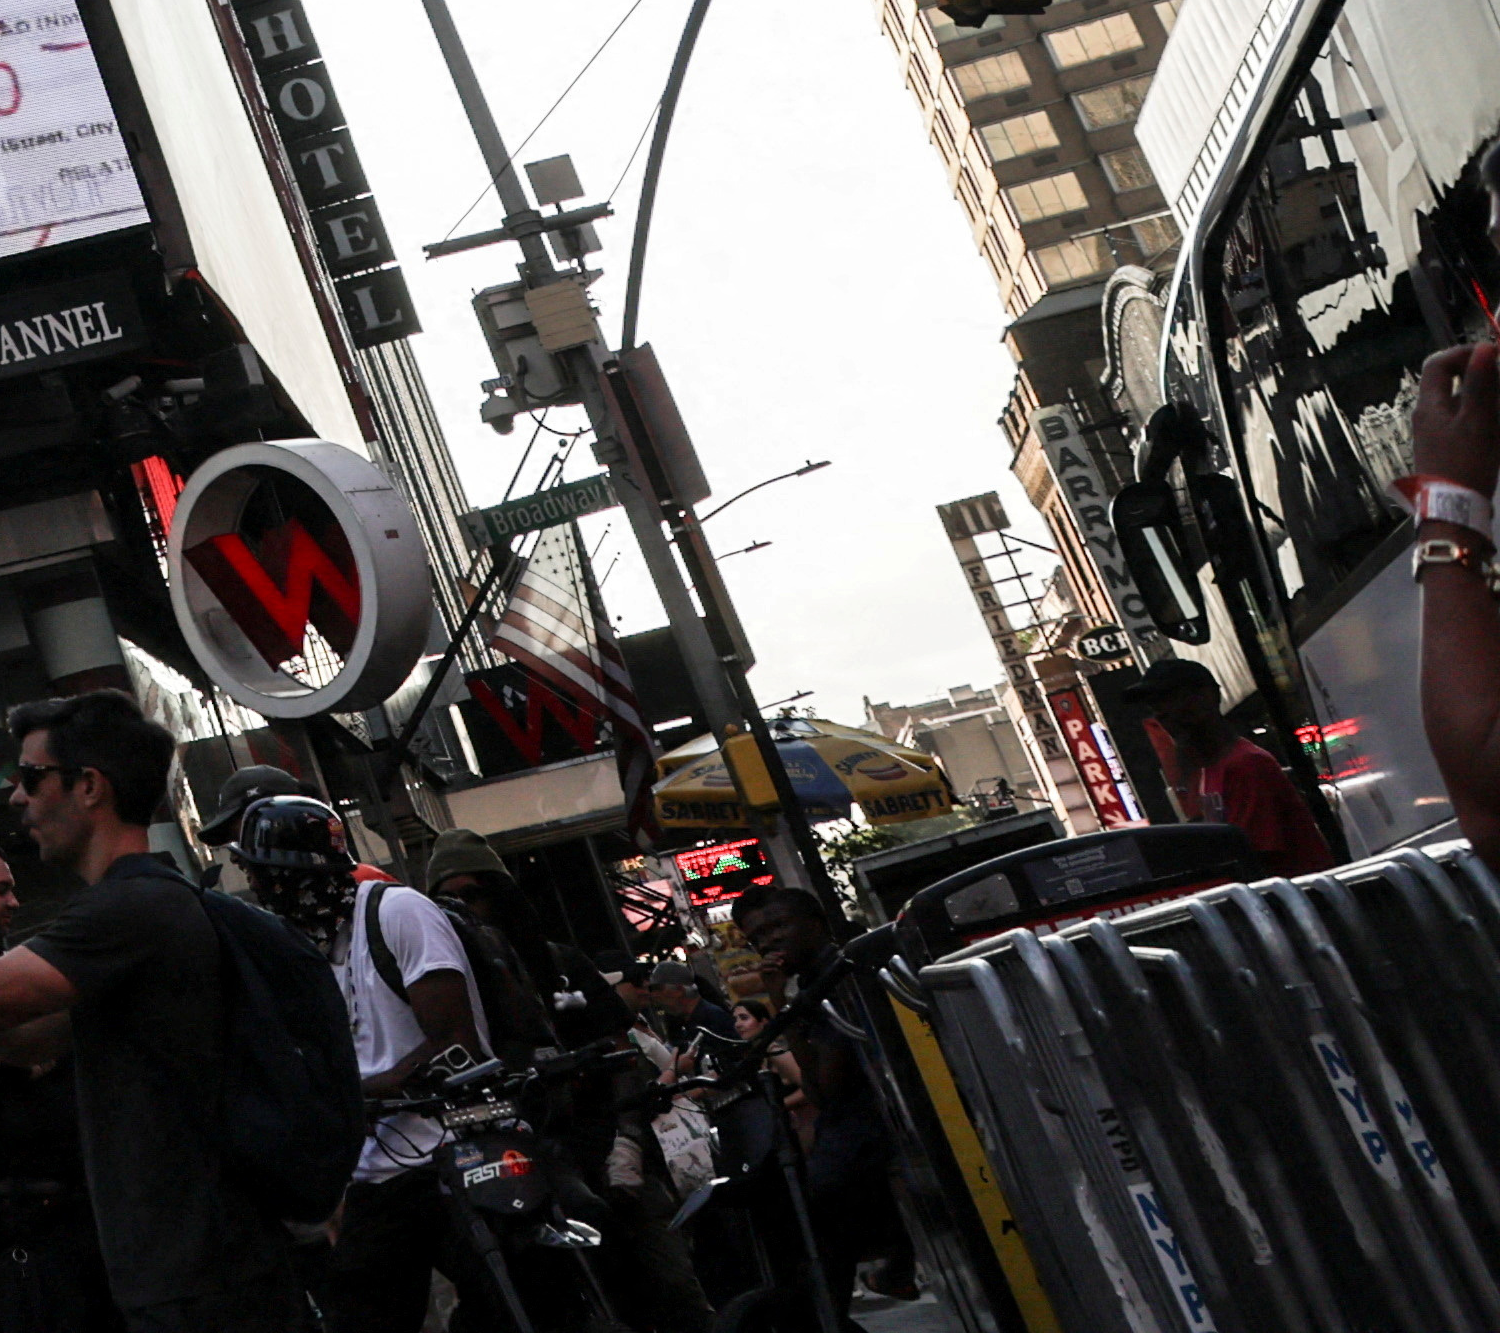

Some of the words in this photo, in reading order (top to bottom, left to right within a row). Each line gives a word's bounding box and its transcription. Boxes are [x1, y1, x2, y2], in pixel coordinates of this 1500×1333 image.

[250, 9, 404, 332] HOTEL
[490, 483, 602, 536] Broadway
[966, 561, 1064, 757] FRIEDMAN
[1065, 717, 1118, 807] PARK
